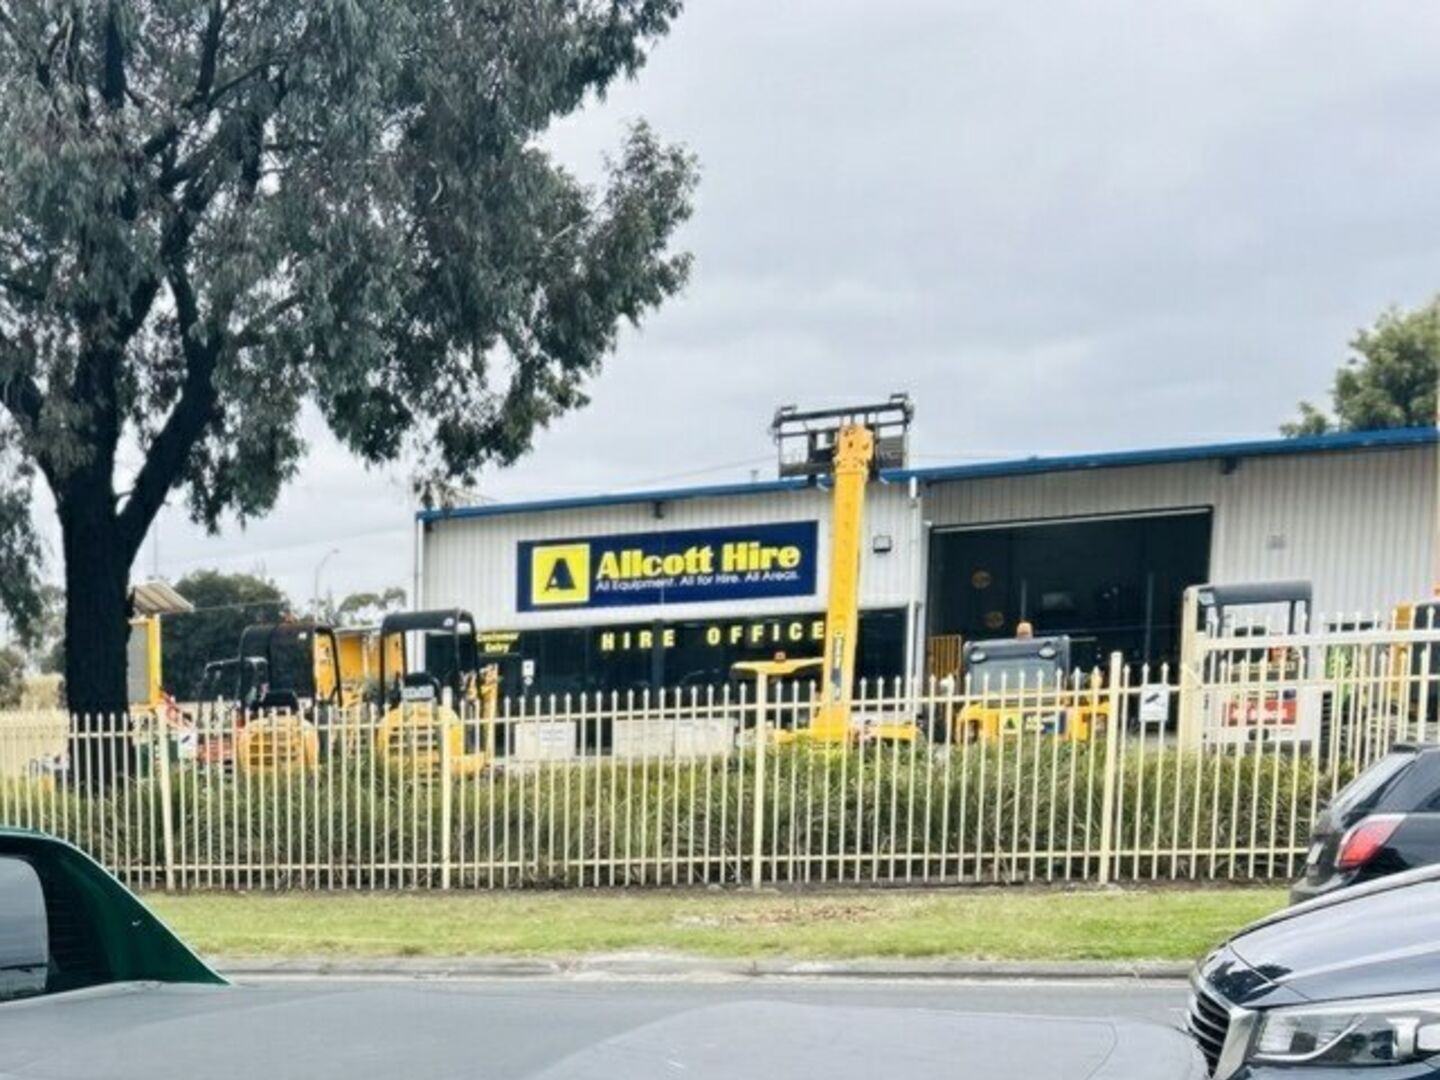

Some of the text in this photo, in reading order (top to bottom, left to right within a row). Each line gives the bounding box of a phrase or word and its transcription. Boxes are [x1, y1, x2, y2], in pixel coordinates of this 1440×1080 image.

[544, 557, 577, 592] A
[595, 540, 801, 580] Allcott Hire
[595, 579, 611, 592] All
[679, 574, 695, 587] All
[744, 571, 760, 583] All
[601, 621, 825, 650] HIRE OFFICE
